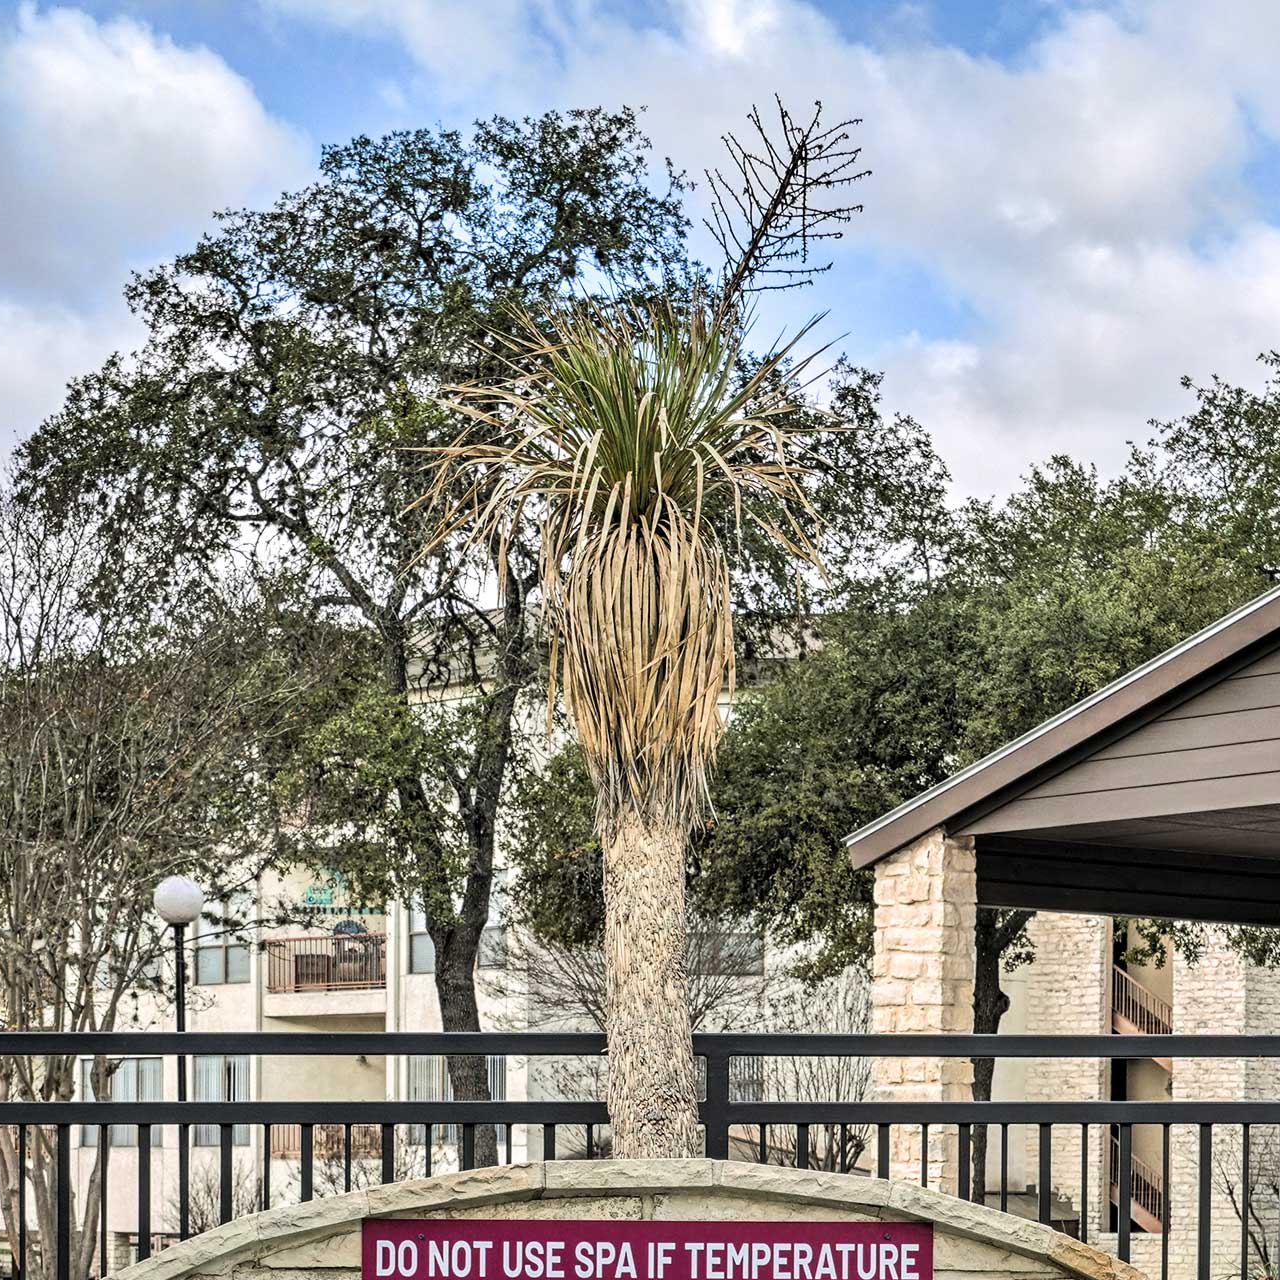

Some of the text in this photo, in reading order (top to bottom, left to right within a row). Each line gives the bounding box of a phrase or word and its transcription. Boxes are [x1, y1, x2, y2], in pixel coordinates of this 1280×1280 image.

[375, 1239, 920, 1280] DO NOT USE SPA IF TEMPERATURE
